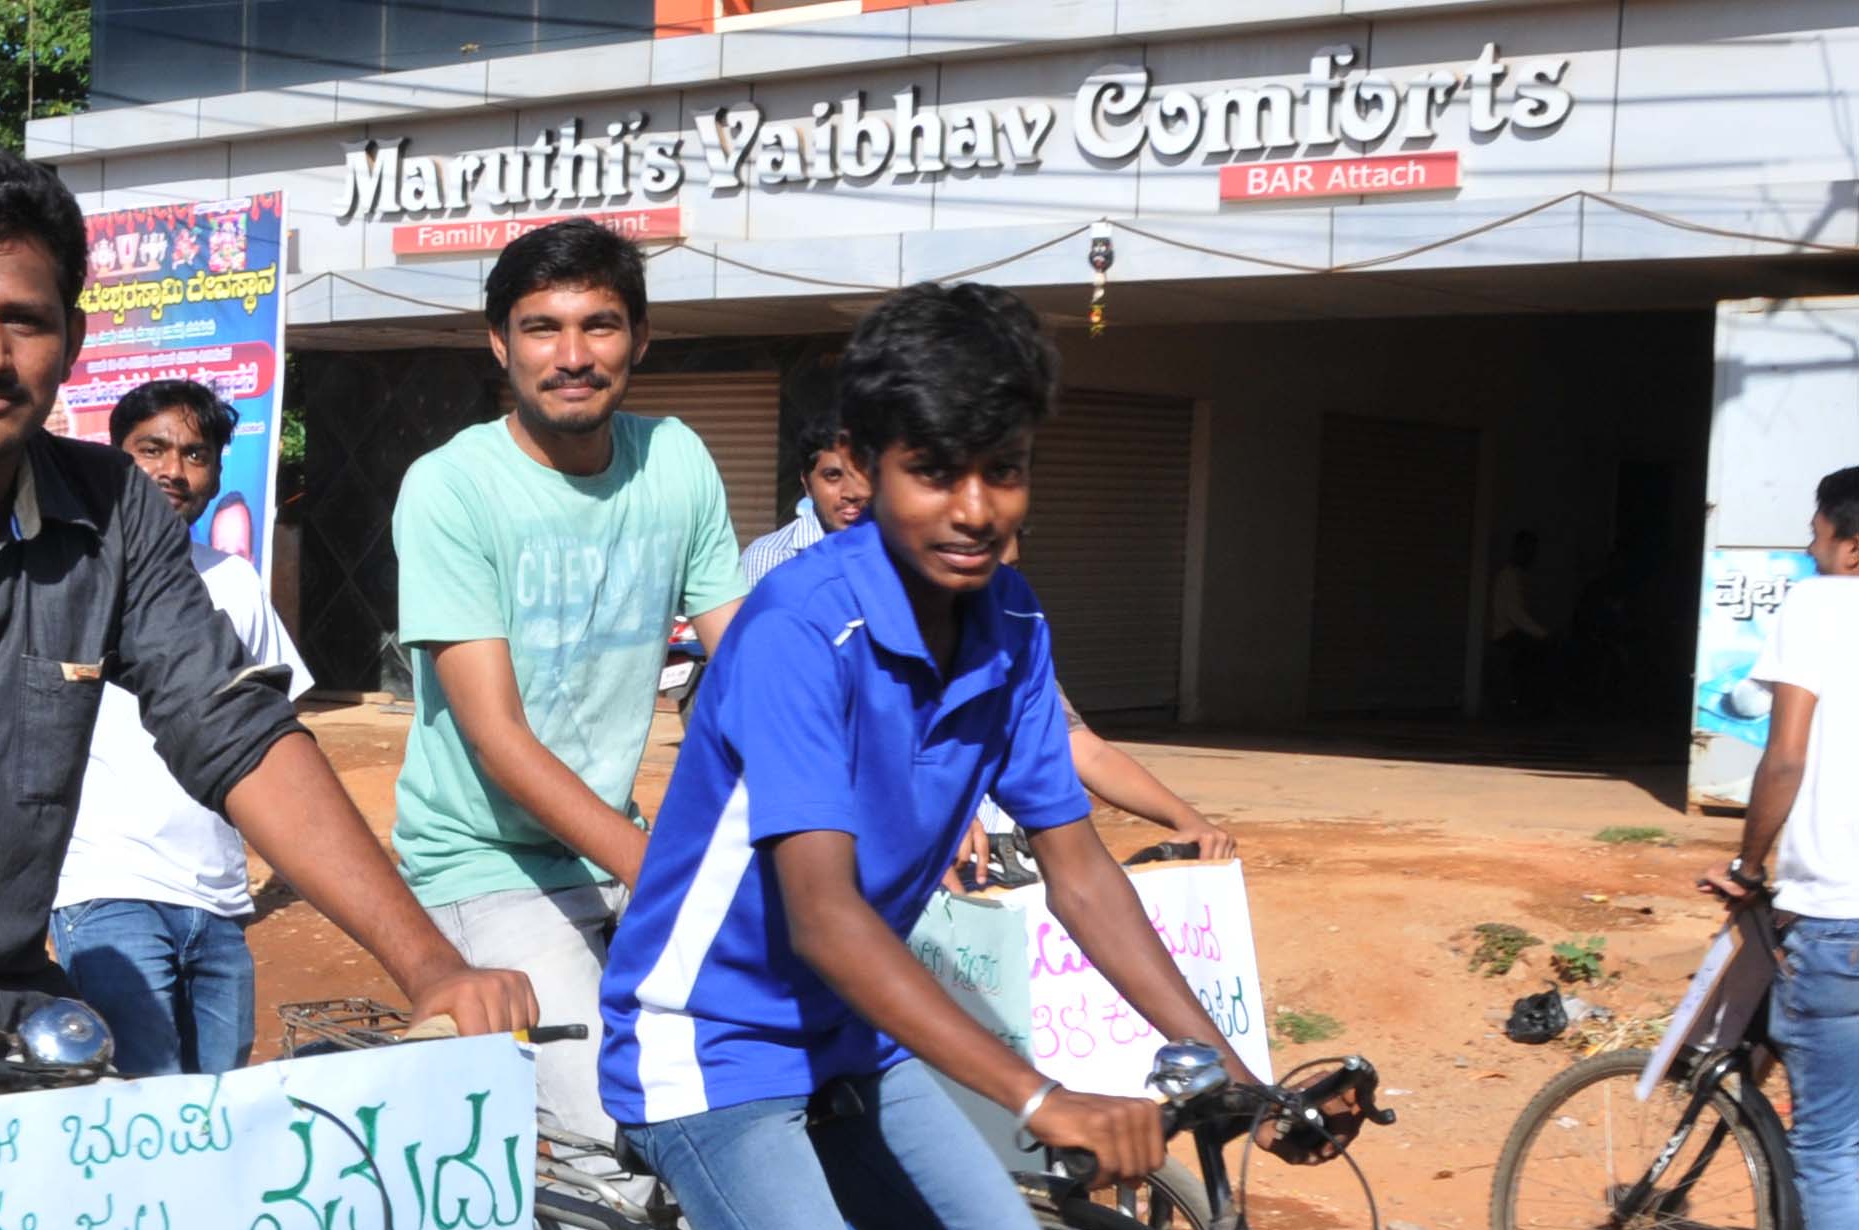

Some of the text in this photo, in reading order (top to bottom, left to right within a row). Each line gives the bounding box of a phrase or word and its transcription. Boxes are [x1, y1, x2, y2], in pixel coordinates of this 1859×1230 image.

[340, 42, 1574, 222] Maruthi's Vaibhav Comforts
[1247, 158, 1426, 195] BAR Attach
[418, 213, 651, 247] Family Reant
[61, 1097, 232, 1180] ಭೂಮಿ
